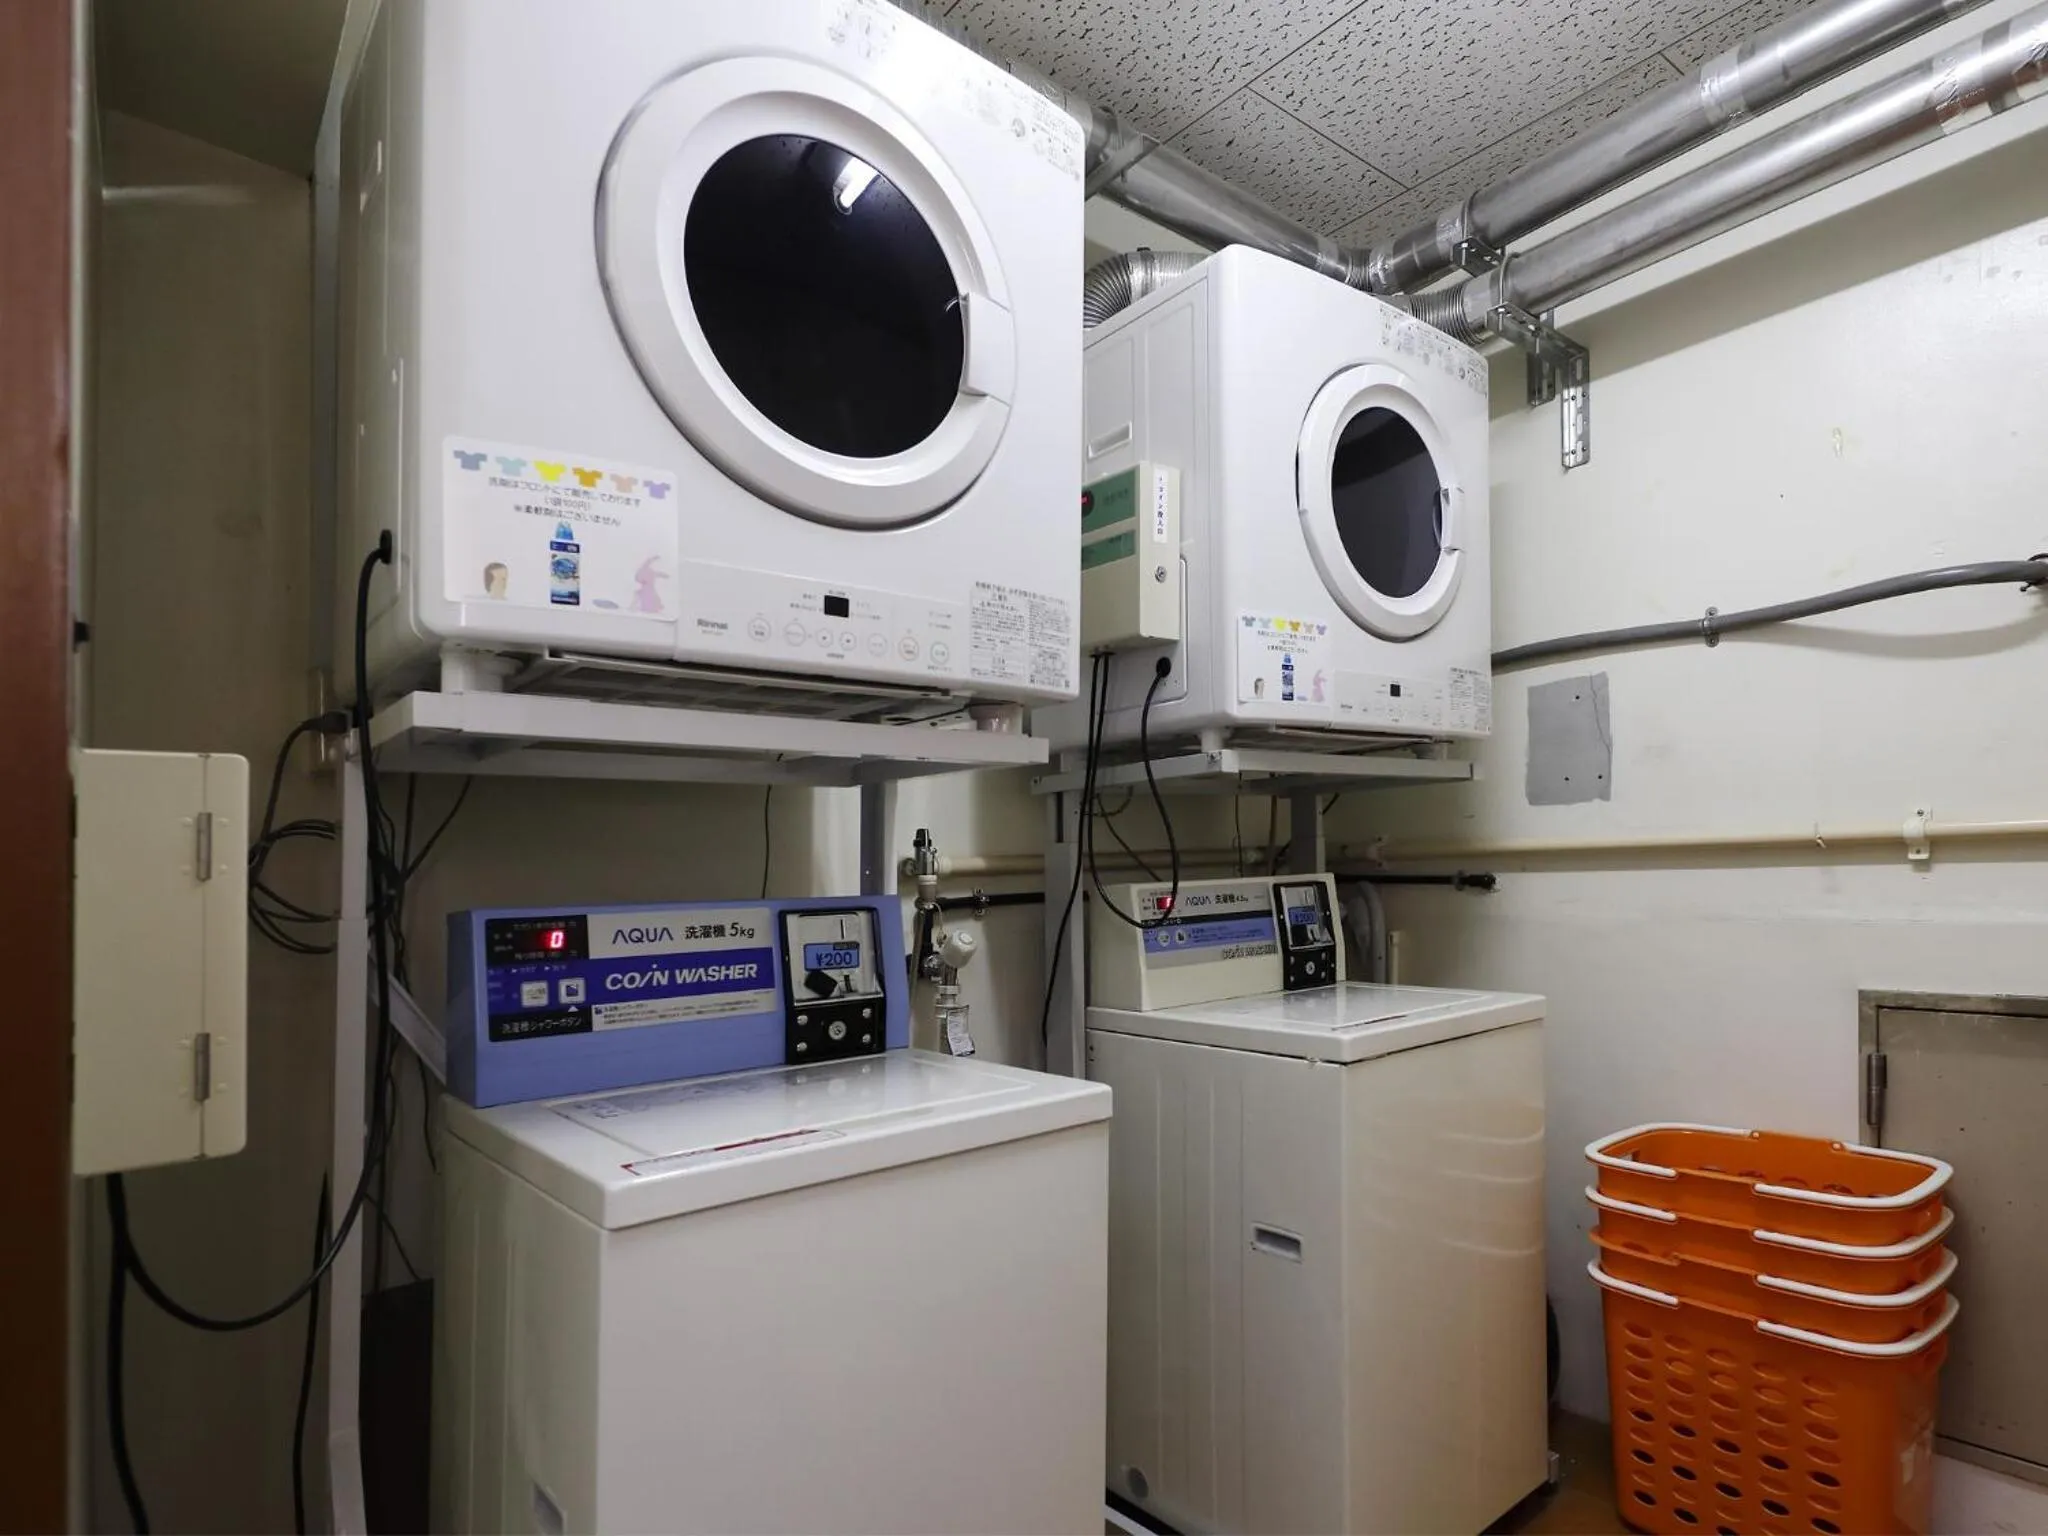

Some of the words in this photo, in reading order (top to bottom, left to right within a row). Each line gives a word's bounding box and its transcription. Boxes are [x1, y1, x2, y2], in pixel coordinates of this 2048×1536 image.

[1185, 896, 1211, 906] AQUA
[550, 930, 564, 949] 0
[612, 927, 674, 945] AQUA
[684, 924, 726, 940] 洗濯機
[729, 922, 755, 939] 5kg
[815, 951, 852, 967] ¥200
[605, 963, 669, 991] COIN
[675, 963, 757, 985] WASHER
